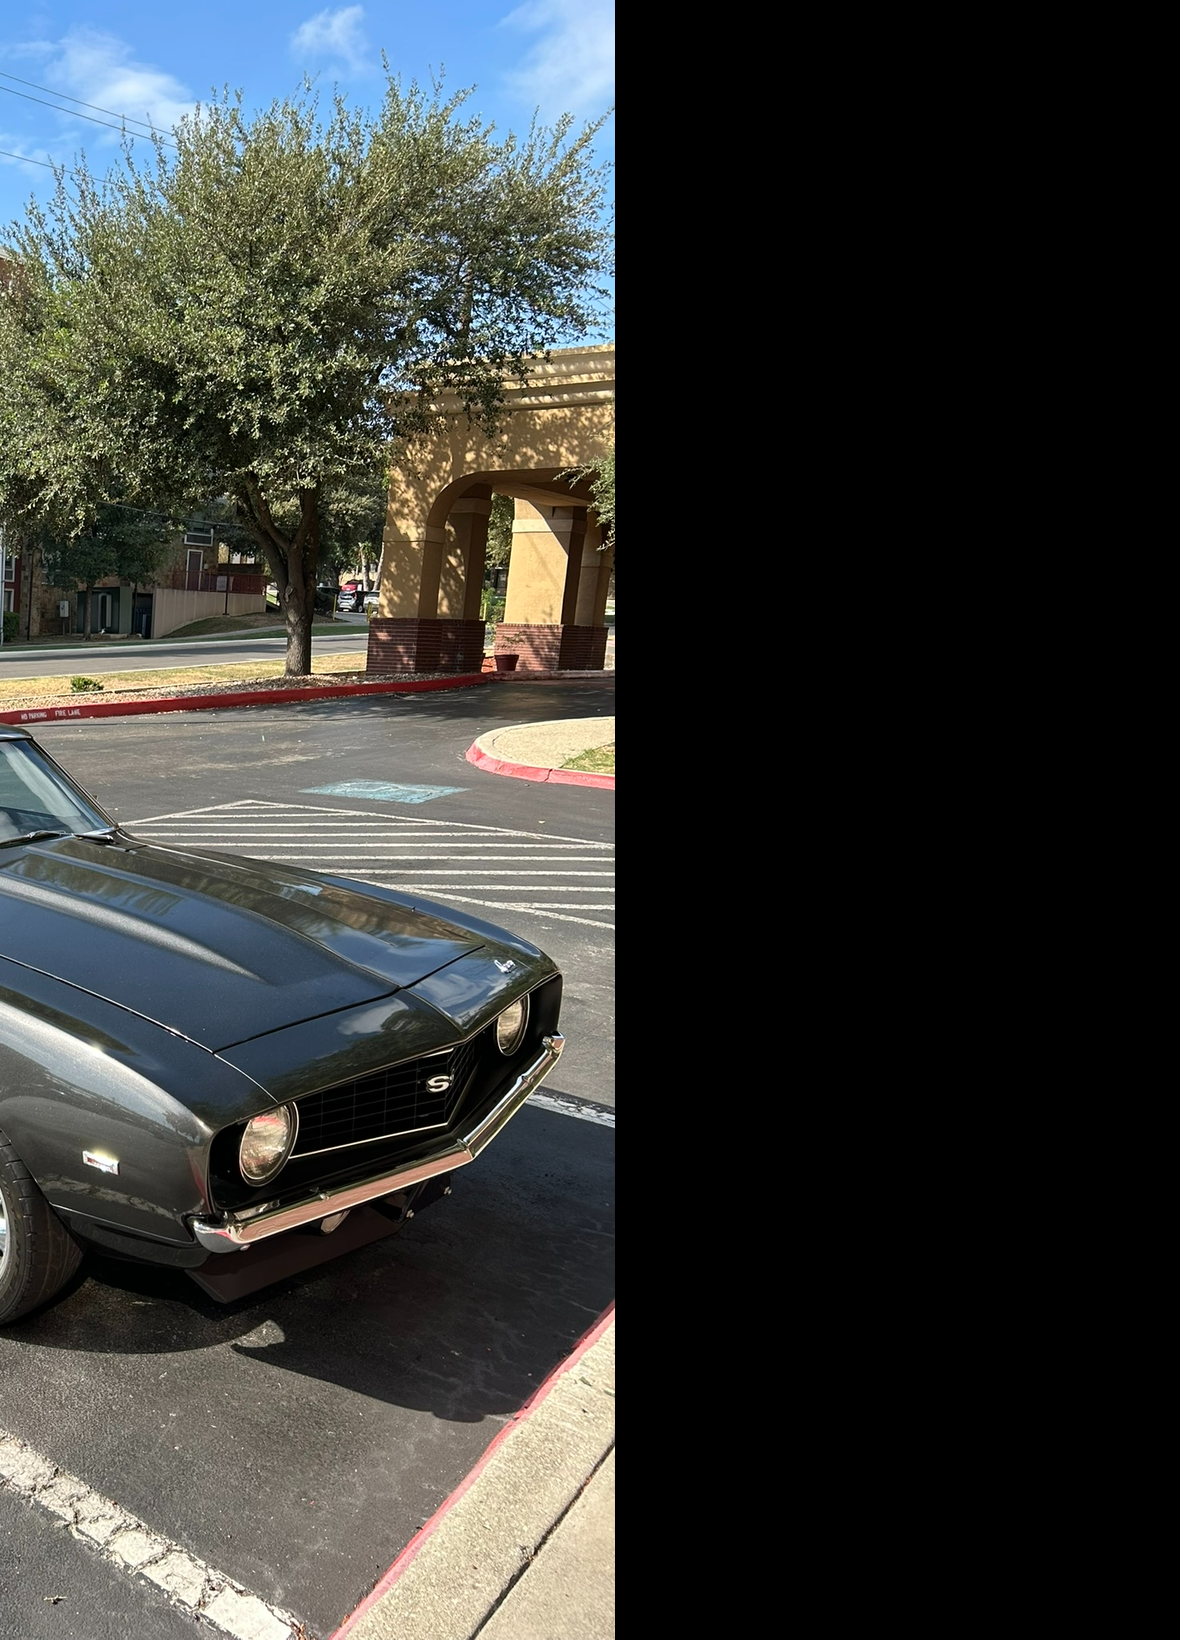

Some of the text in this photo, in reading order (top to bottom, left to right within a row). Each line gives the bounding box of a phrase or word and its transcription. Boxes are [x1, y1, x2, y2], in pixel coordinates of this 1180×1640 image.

[28, 711, 47, 719] PARKING
[54, 709, 67, 717] FIRE
[67, 708, 81, 716] LANE
[427, 1074, 454, 1093] S
